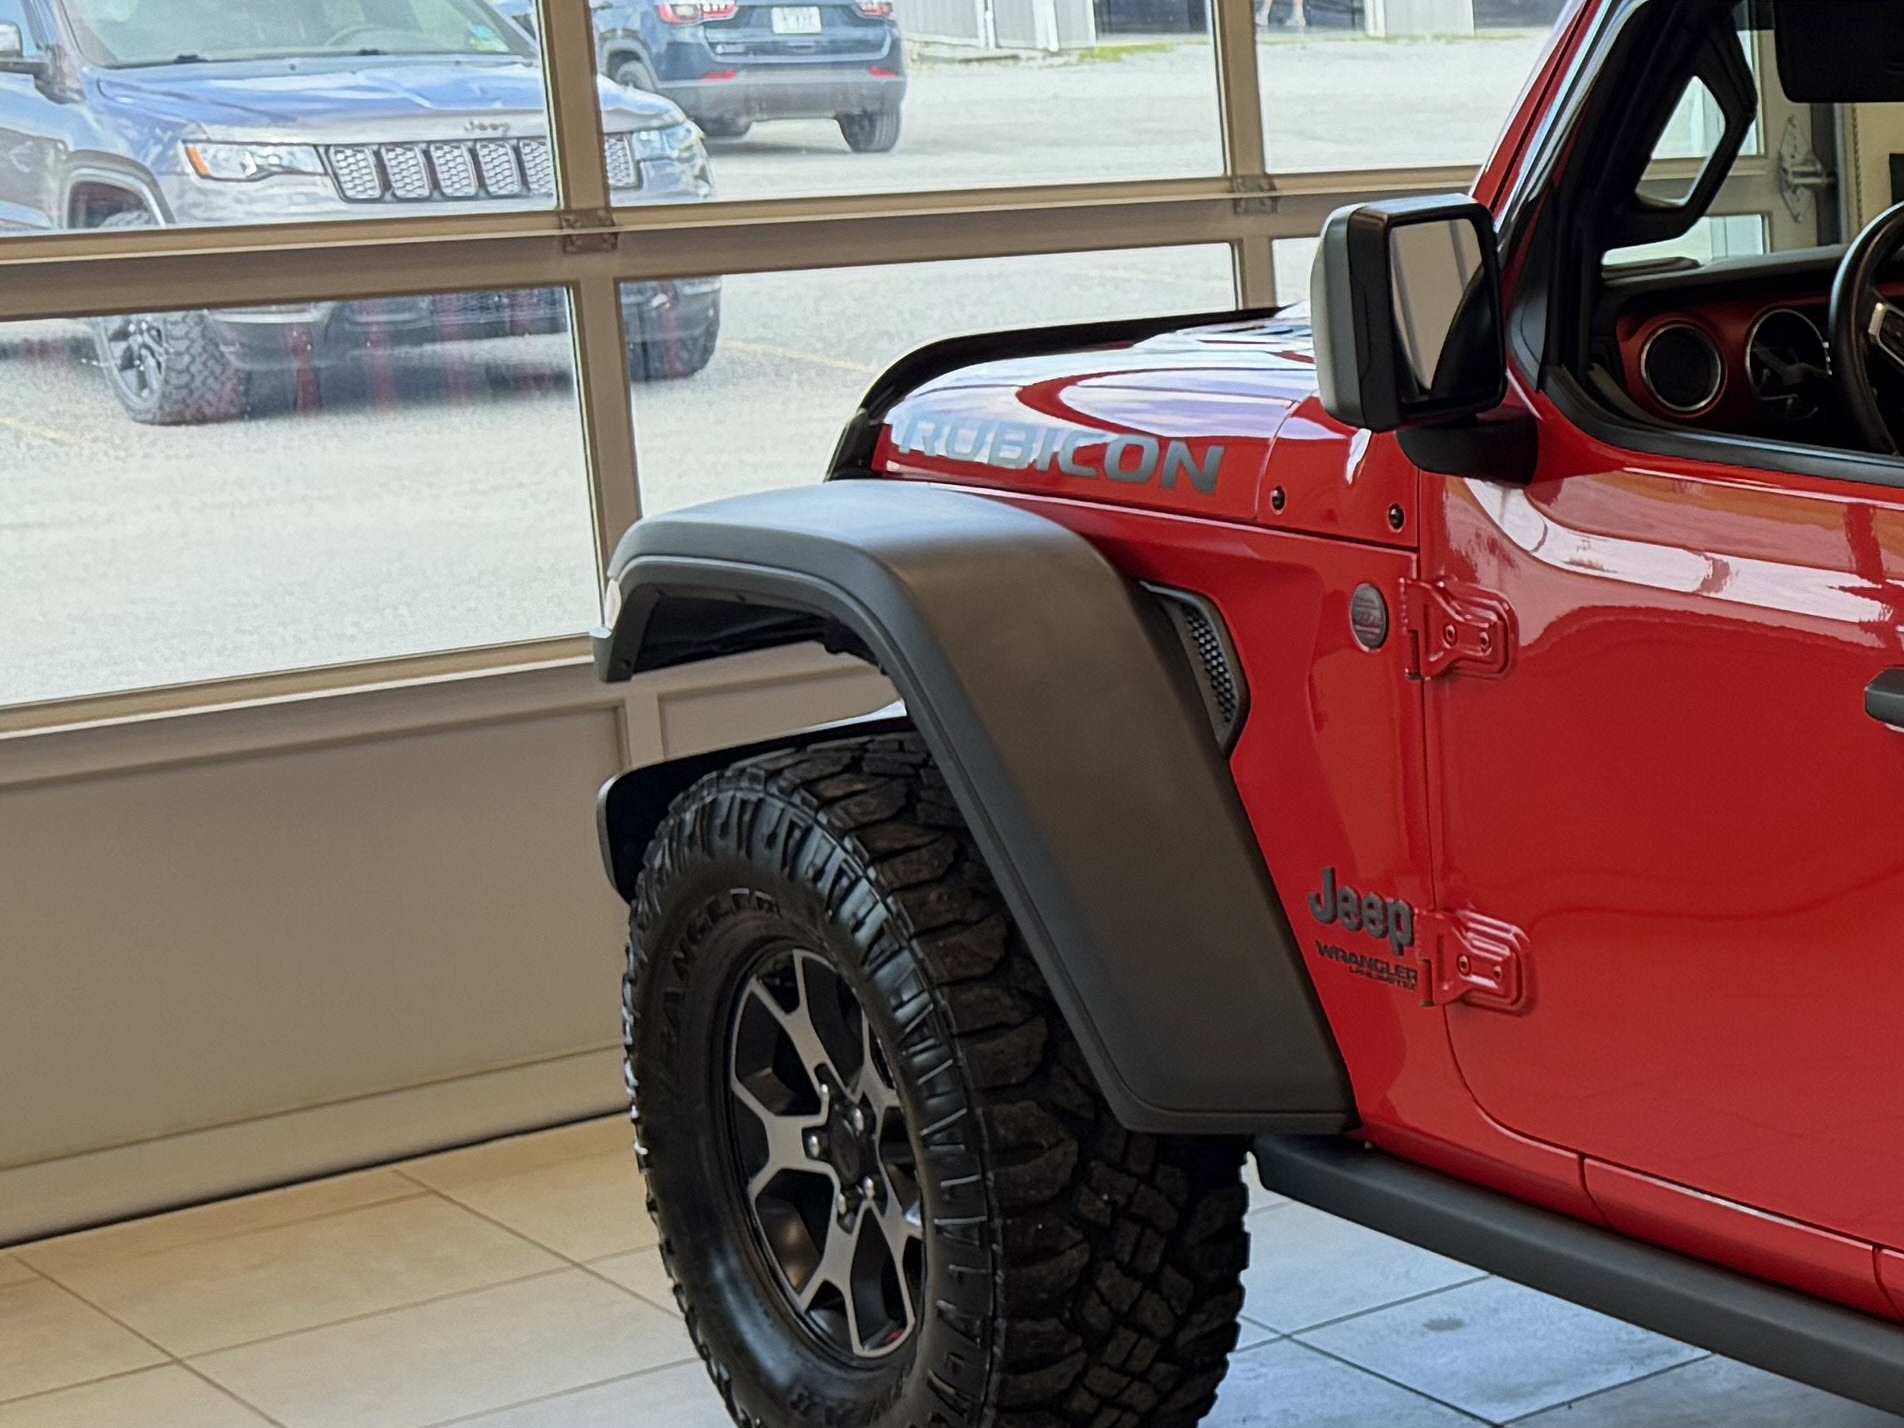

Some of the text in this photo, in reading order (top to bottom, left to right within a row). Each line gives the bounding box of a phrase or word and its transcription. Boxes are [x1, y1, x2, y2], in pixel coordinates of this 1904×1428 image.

[899, 419, 1225, 497] RUBICON
[1308, 866, 1414, 957] Jeep
[1315, 939, 1418, 982] WRANGLER
